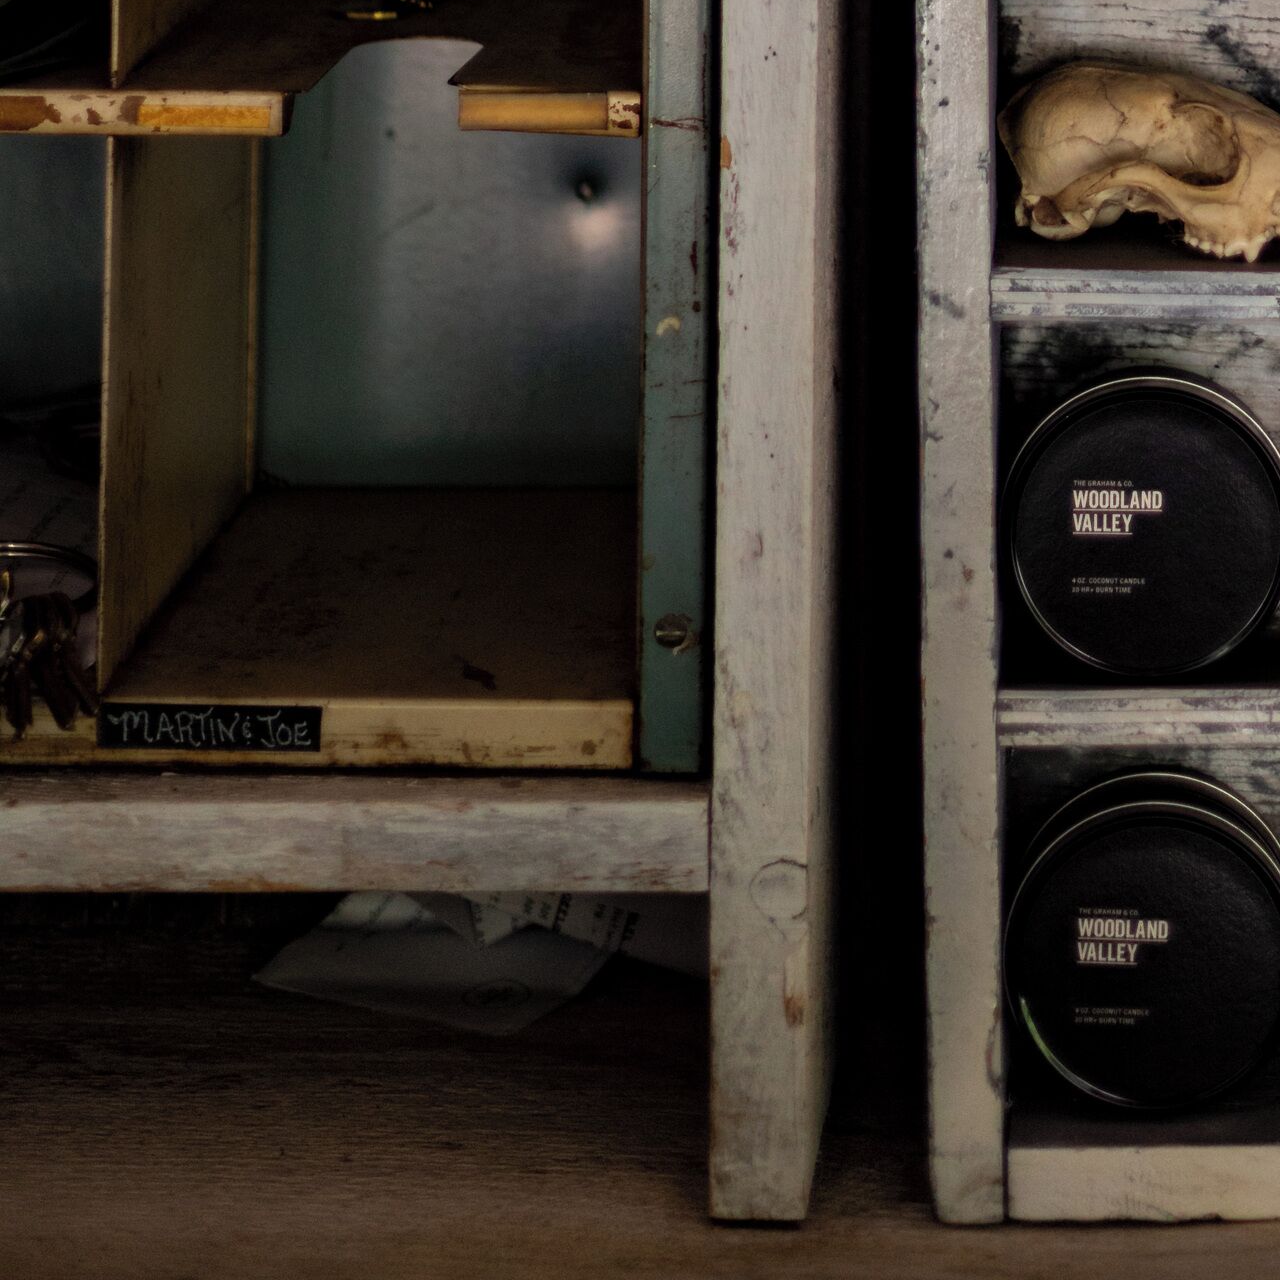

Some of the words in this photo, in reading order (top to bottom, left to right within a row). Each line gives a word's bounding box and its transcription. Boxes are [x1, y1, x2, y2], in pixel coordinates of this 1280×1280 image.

[1073, 490, 1163, 509] WOODLAND
[1073, 513, 1132, 532] VALLEY
[107, 707, 240, 748] MARTIN
[256, 710, 311, 748] JOE
[1078, 918, 1168, 939] WOODLAND
[1078, 942, 1137, 962] VALLEY
